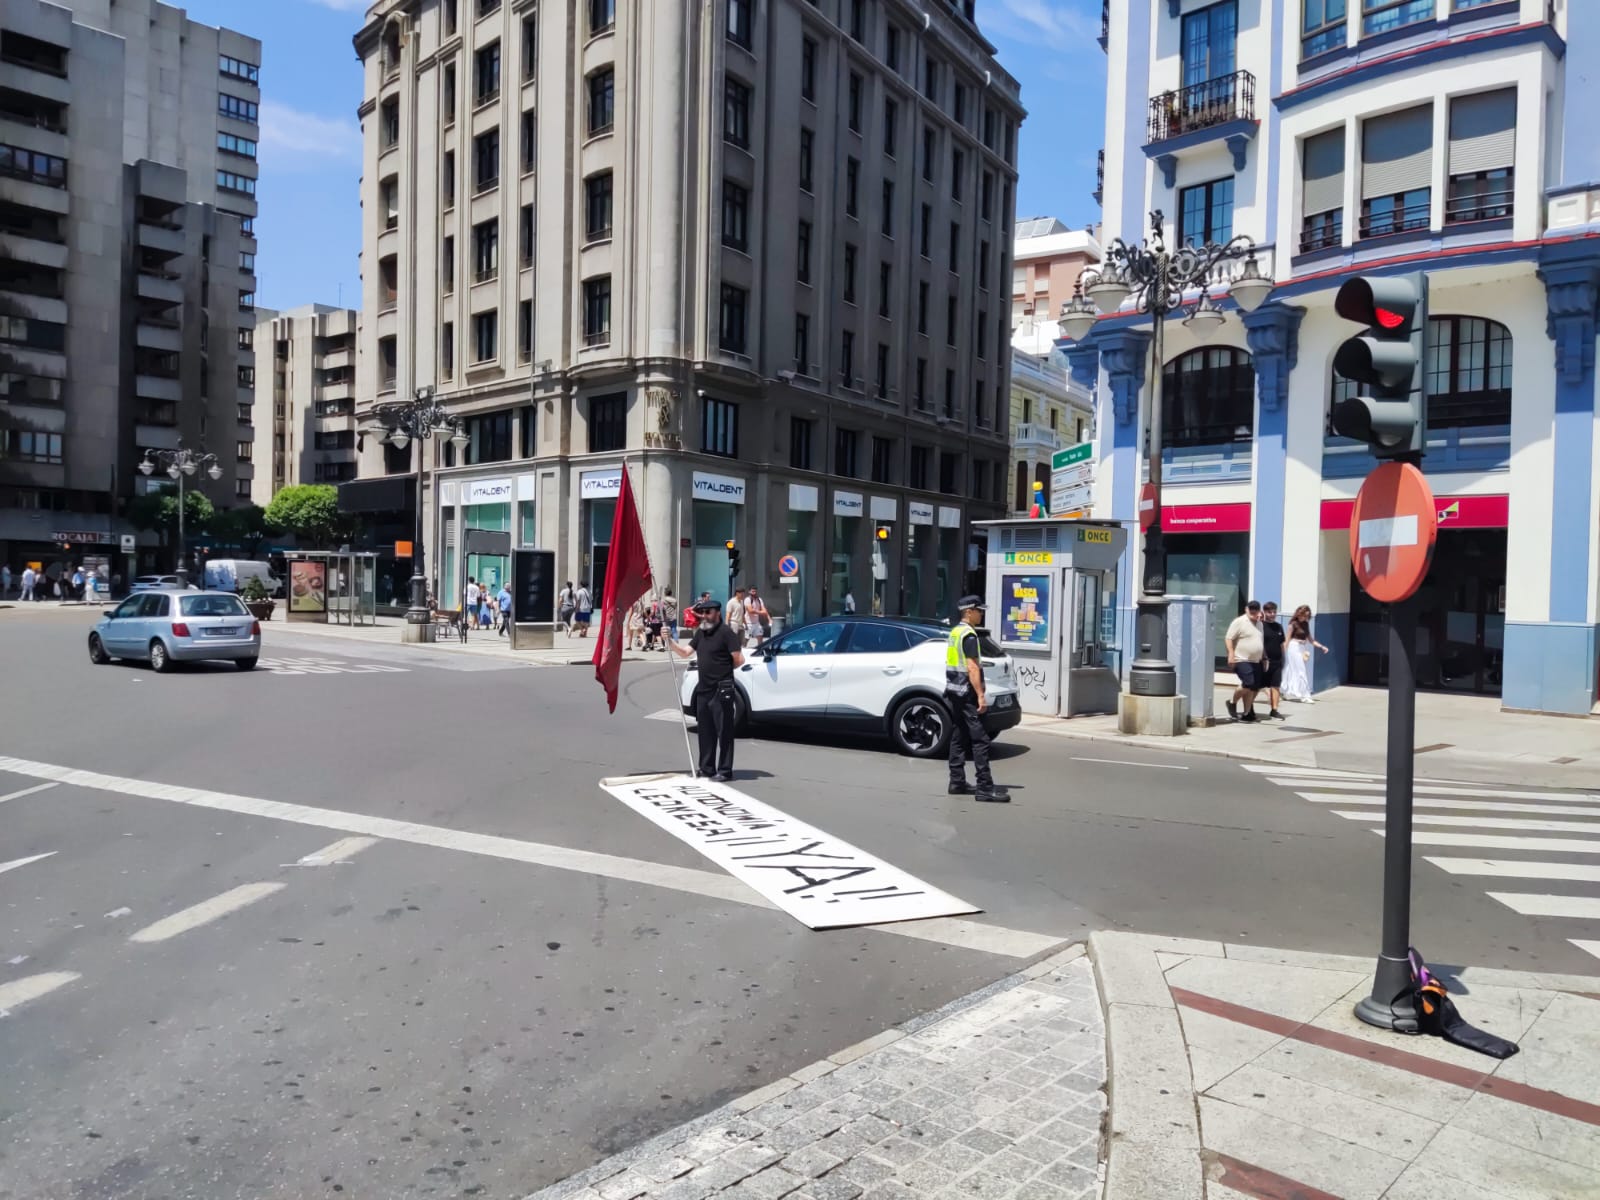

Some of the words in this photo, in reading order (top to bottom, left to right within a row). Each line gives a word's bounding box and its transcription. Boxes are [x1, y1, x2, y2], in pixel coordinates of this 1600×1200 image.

[584, 479, 621, 489] VITALDE
[694, 480, 744, 495] VITALDENT
[472, 486, 511, 496] VITALDENT
[835, 500, 862, 509] VITALDENT
[1087, 531, 1110, 542] ONCE
[1019, 553, 1049, 563] ONCE
[633, 788, 737, 837] LEONESA
[672, 785, 785, 830] AUTONOMÍA
